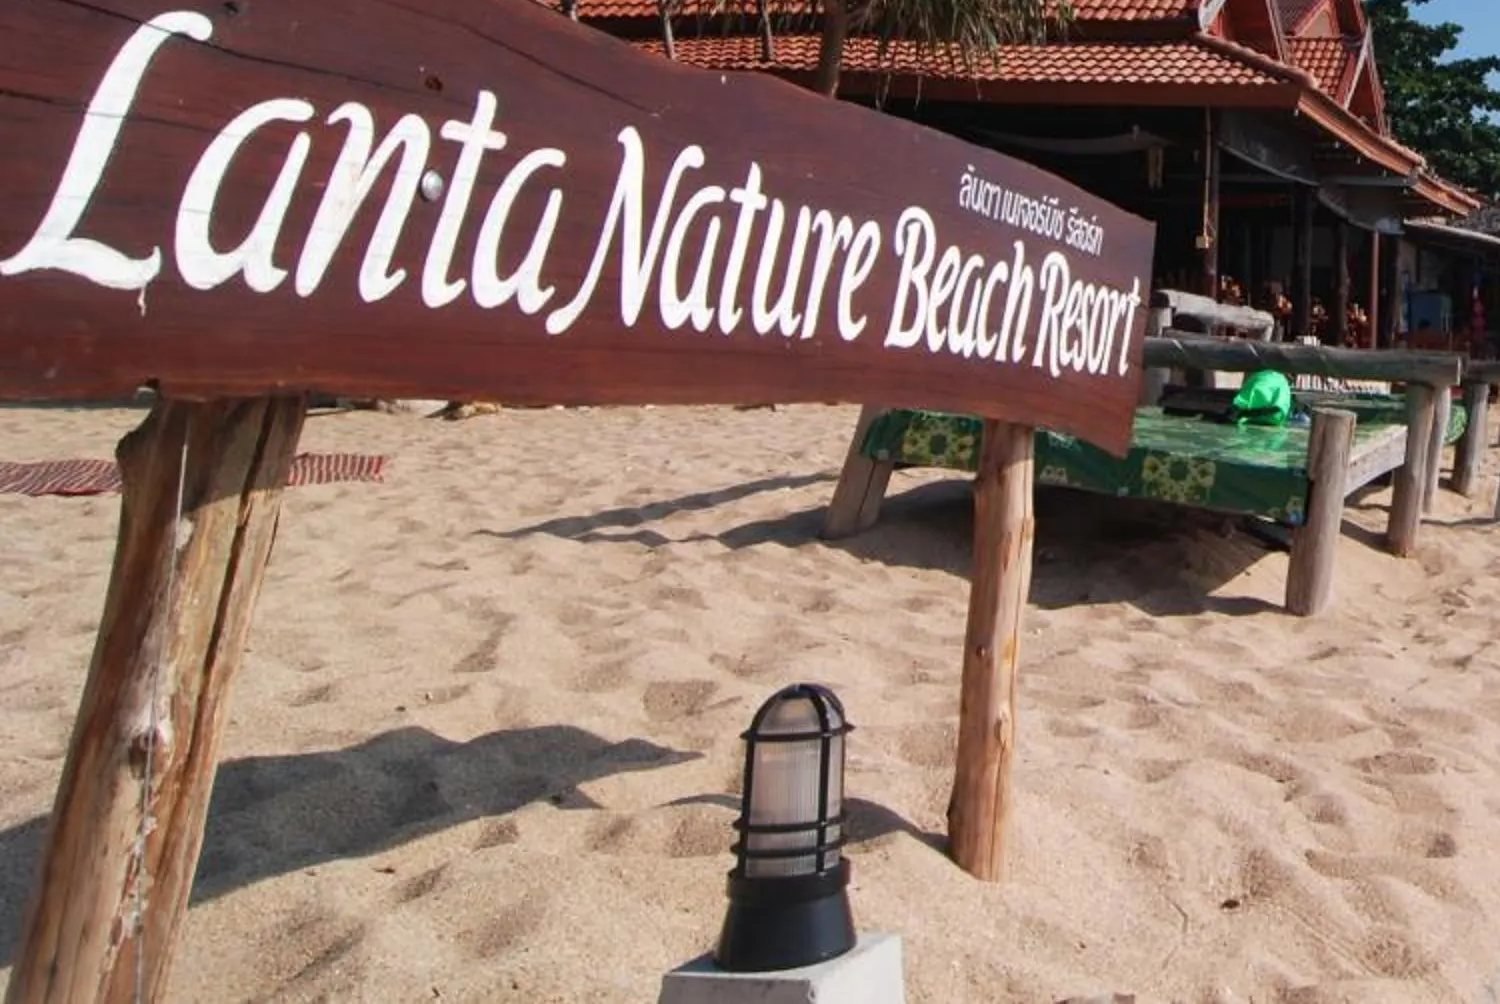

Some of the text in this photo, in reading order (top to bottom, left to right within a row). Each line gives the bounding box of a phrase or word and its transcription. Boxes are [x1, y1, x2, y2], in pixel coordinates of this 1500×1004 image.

[0, 10, 1142, 377] Lanta Nature Beach Resort
